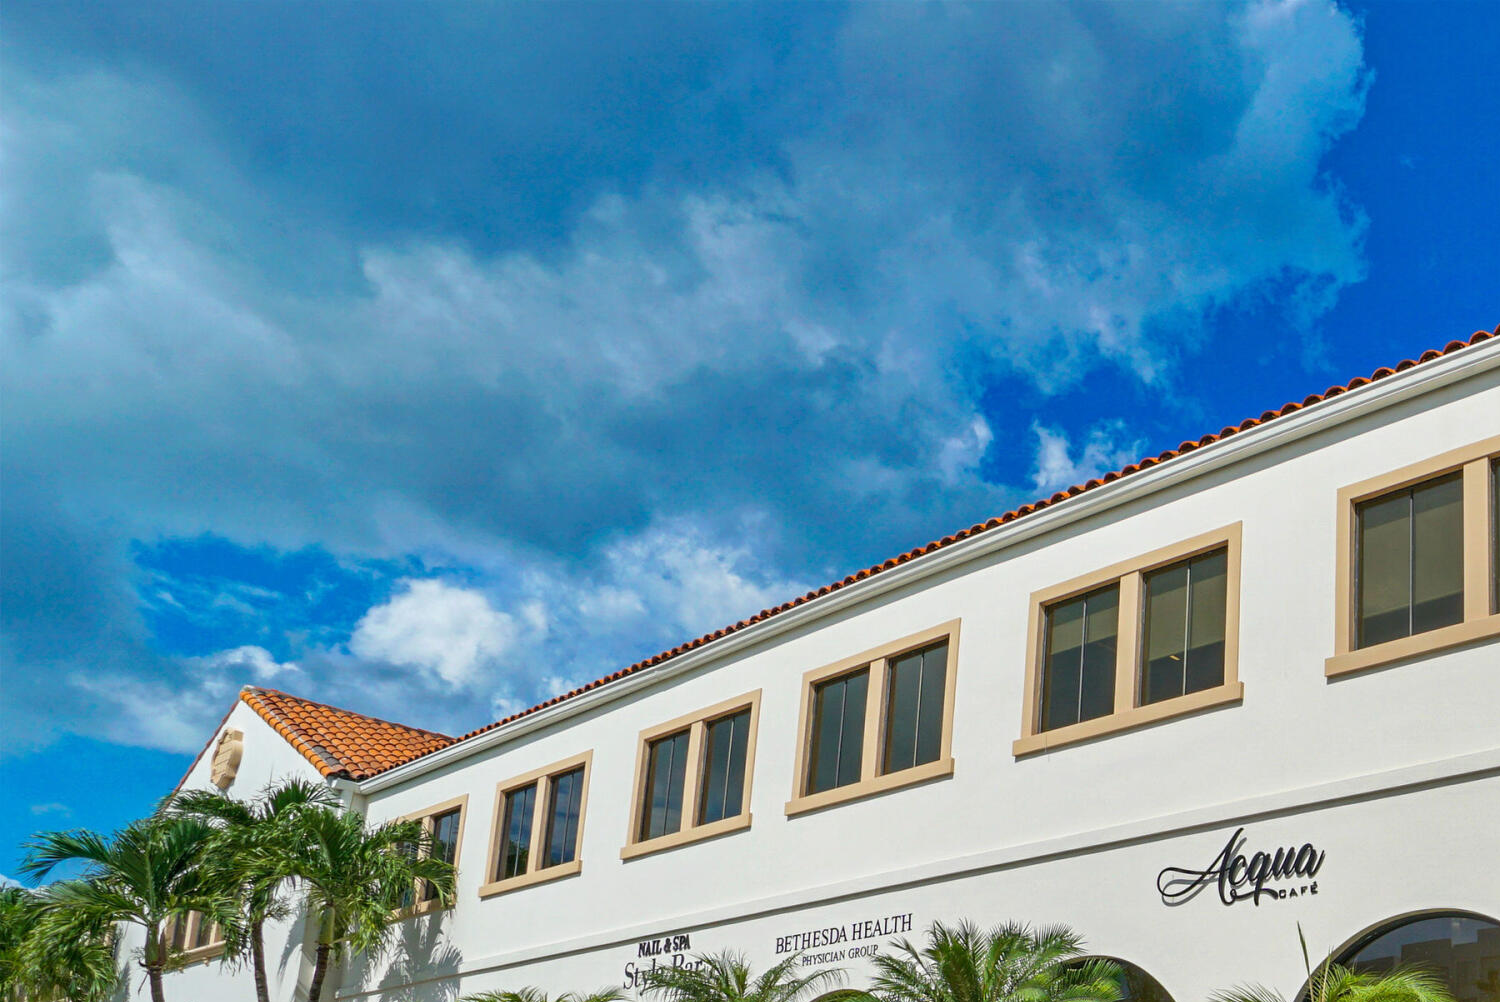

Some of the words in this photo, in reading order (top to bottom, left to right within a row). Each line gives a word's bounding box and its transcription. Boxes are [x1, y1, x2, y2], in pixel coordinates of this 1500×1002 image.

[1157, 827, 1326, 906] Acqua
[1278, 881, 1319, 900] CAFÉ
[775, 925, 848, 954] BETHESDA
[852, 913, 913, 941] HEALTH
[638, 940, 662, 958] NAIL
[663, 938, 672, 954] &
[673, 934, 691, 951] SPA
[802, 950, 846, 967] PHYSICIAN
[848, 944, 879, 960] GROUP
